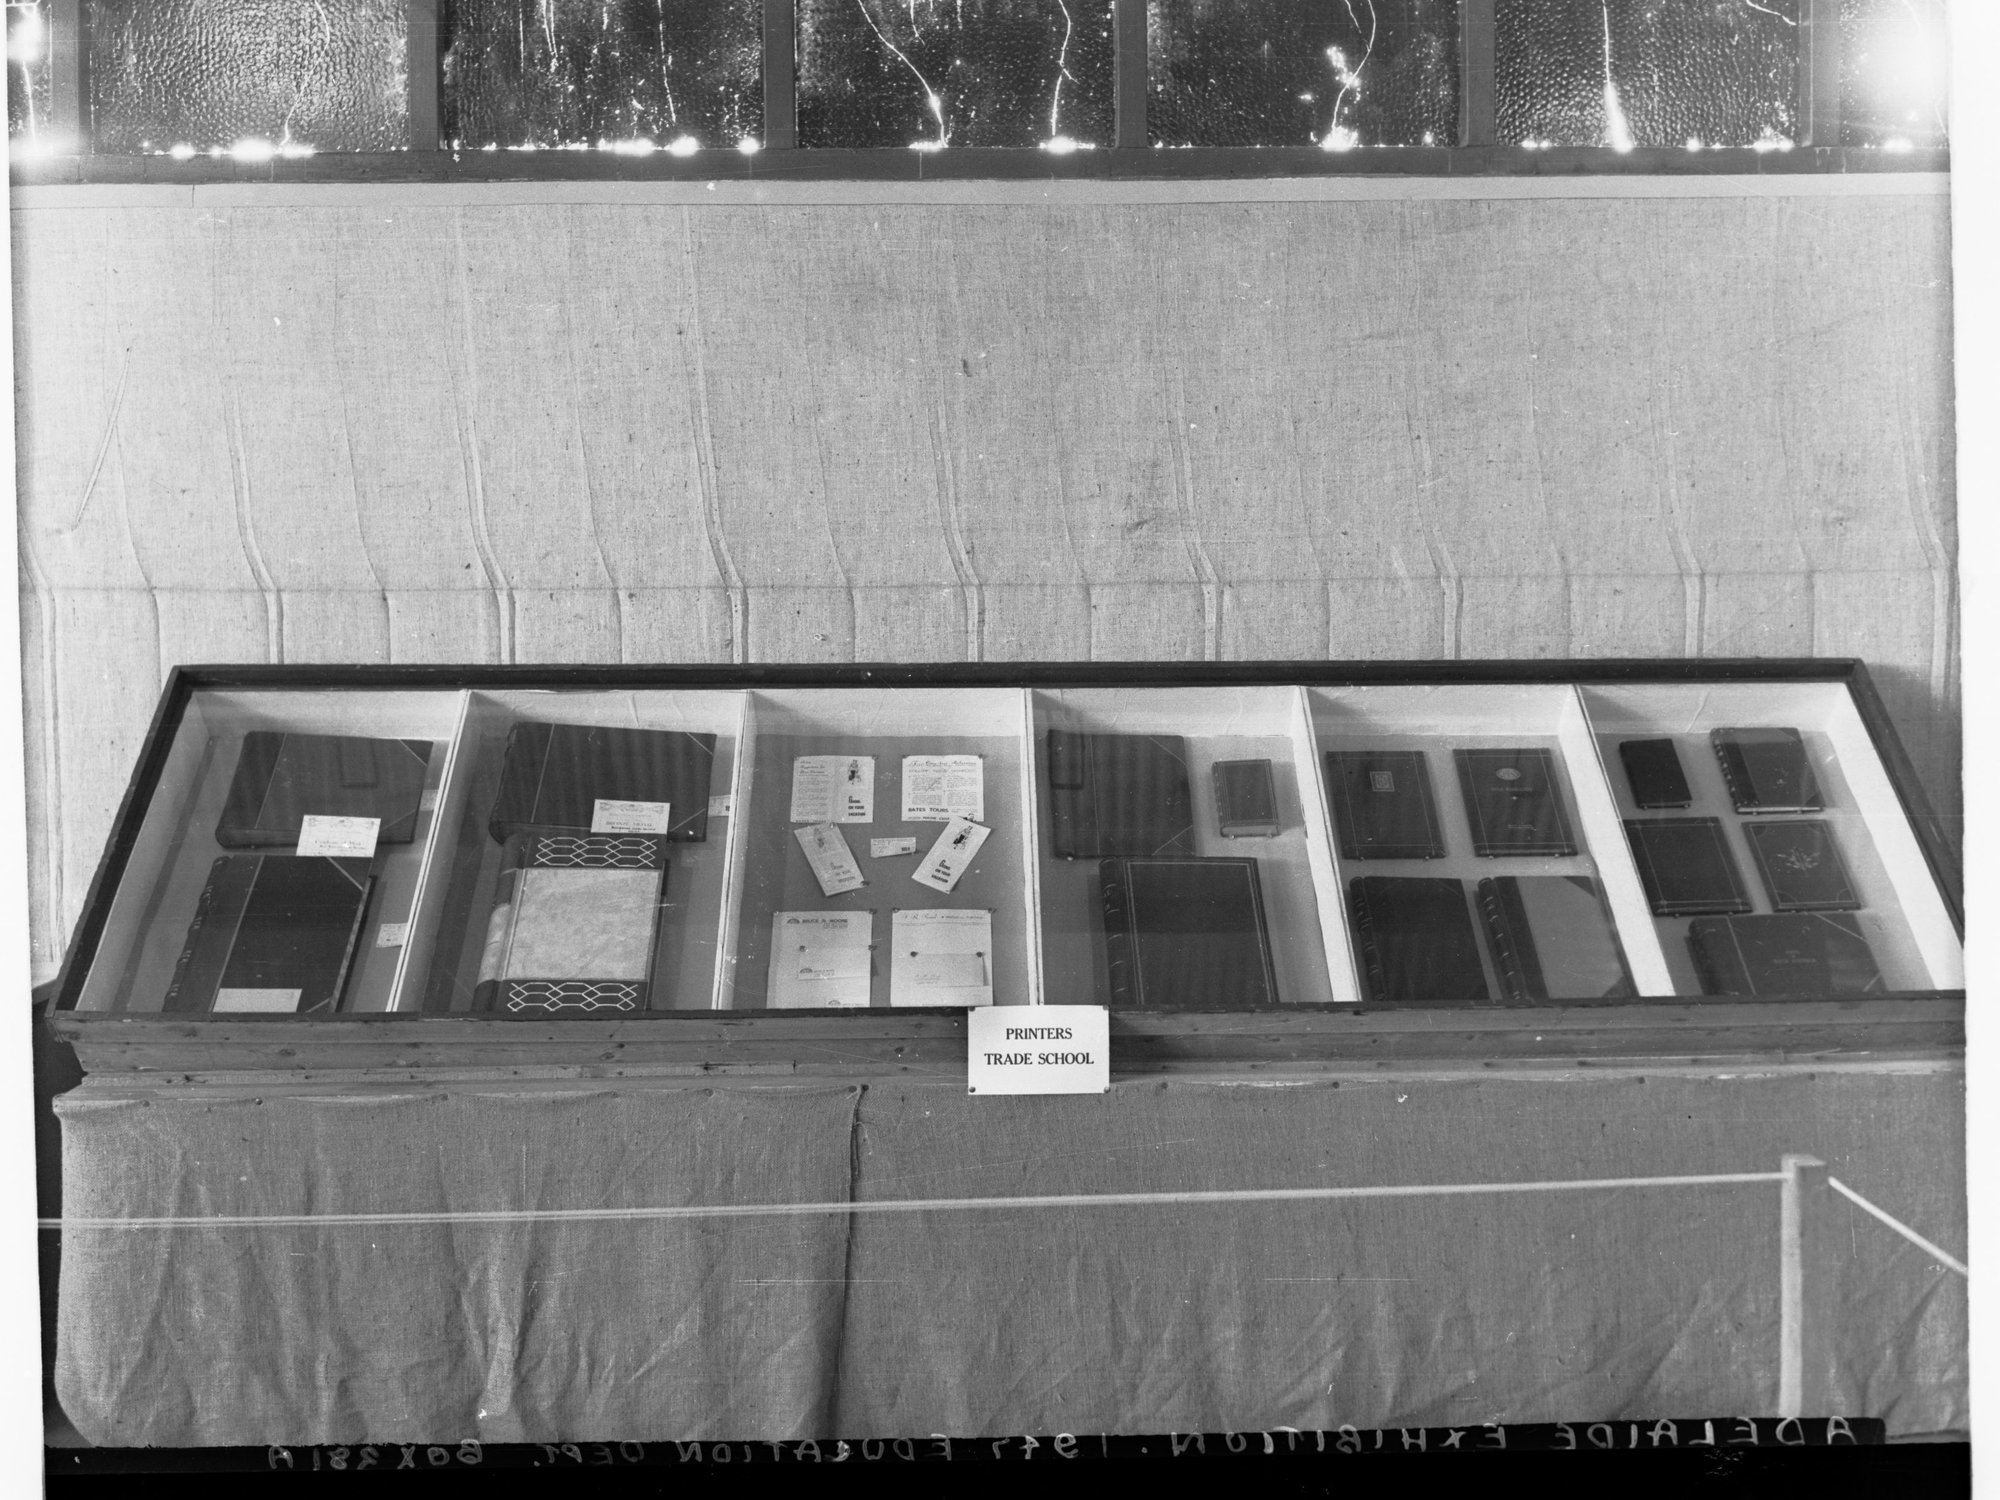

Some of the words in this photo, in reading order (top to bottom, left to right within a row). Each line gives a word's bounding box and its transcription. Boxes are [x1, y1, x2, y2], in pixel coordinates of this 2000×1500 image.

[1005, 1027, 1073, 1040] PRINTERS
[983, 1052, 1033, 1065] TRADE
[1038, 1052, 1095, 1065] SCHOOL
